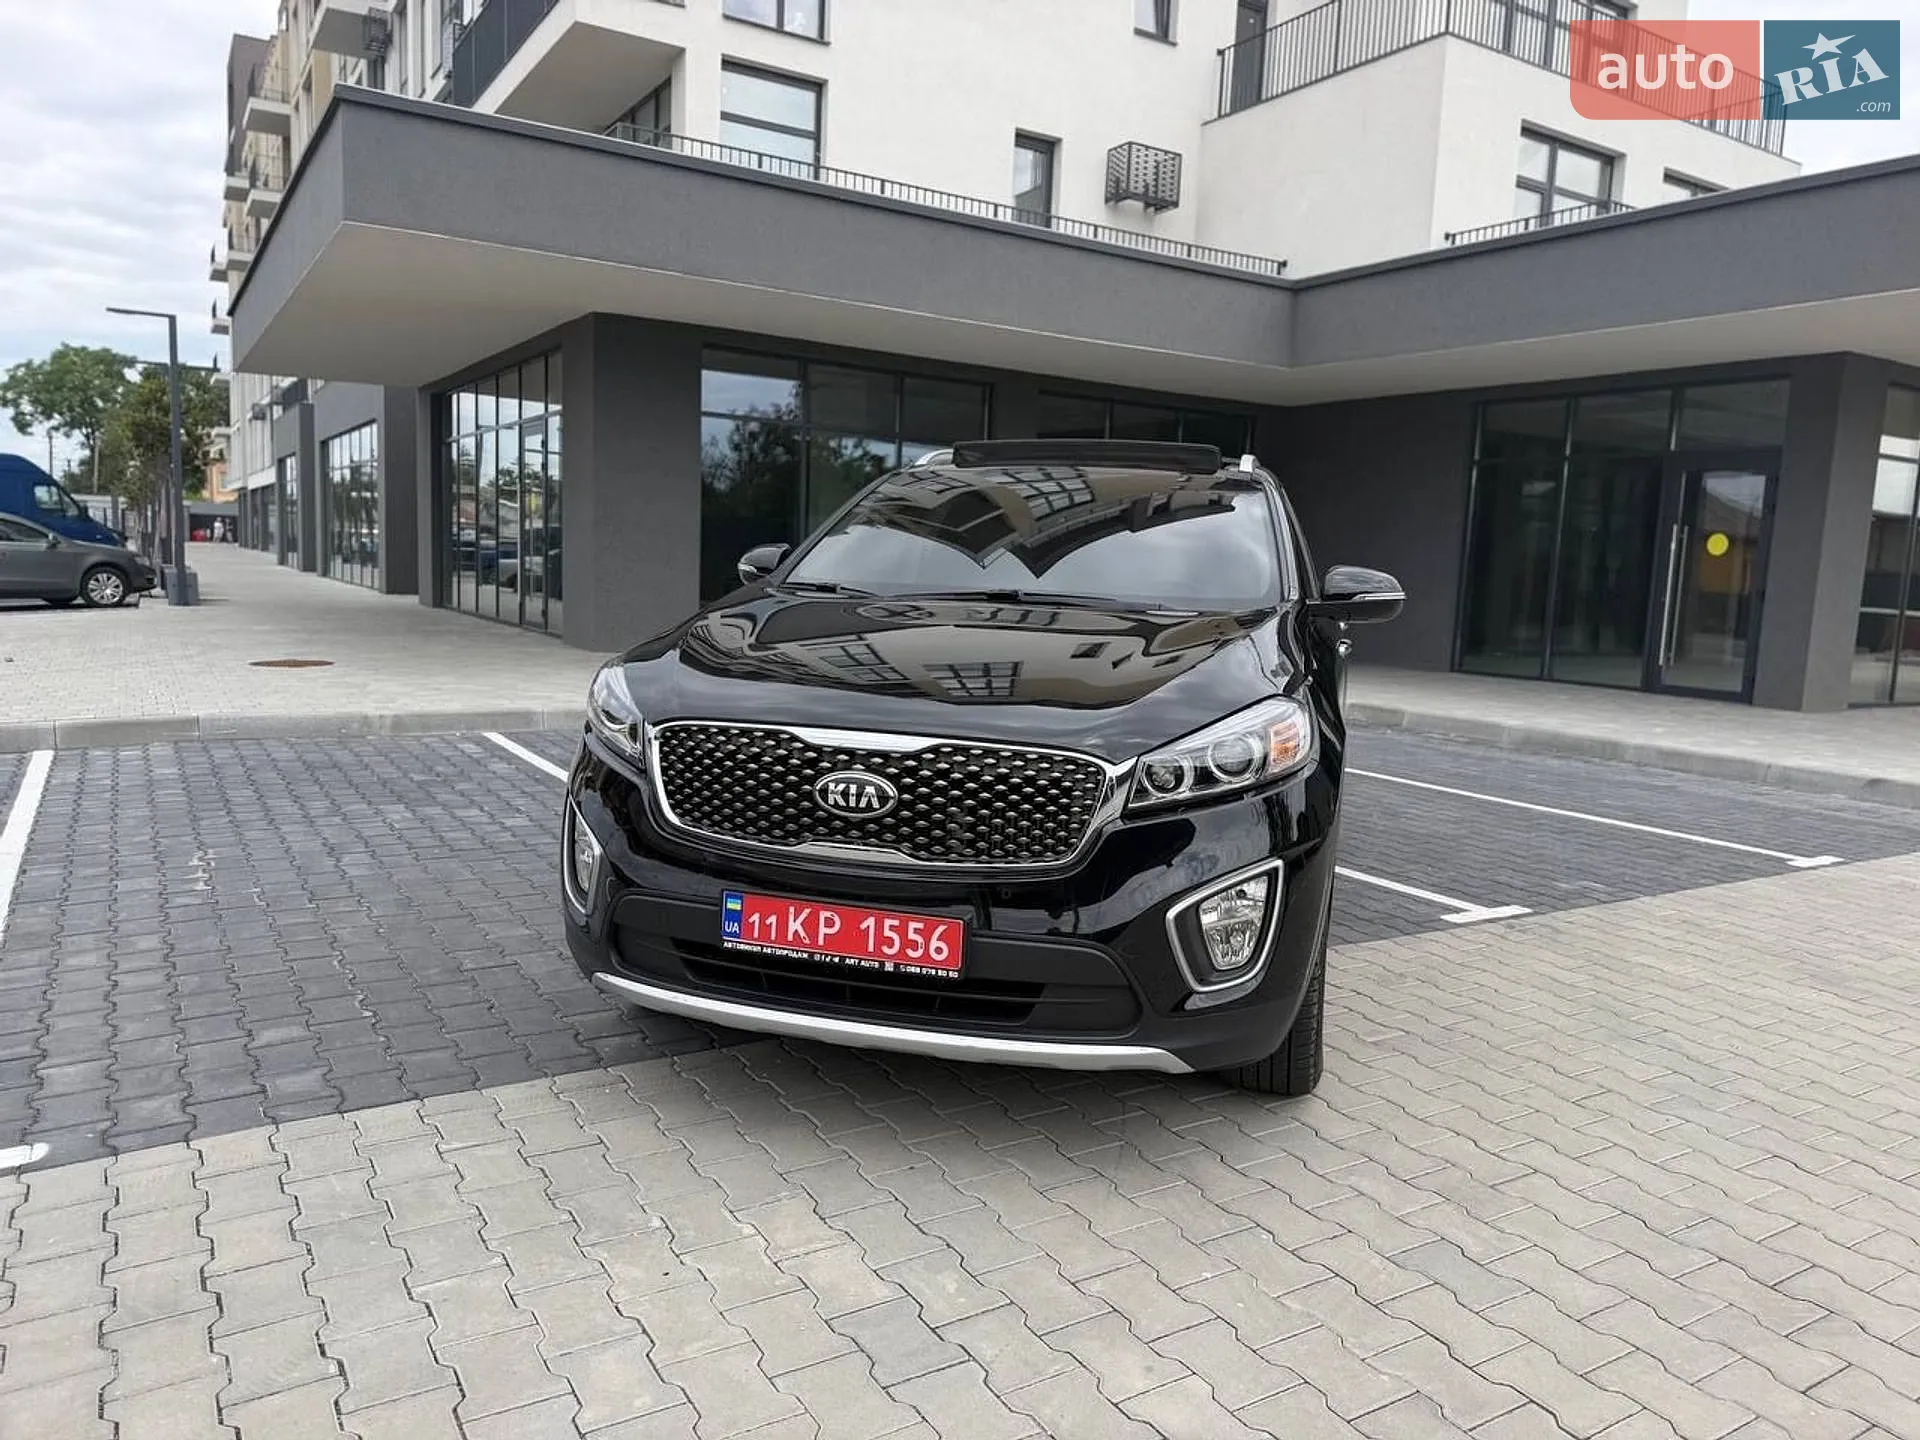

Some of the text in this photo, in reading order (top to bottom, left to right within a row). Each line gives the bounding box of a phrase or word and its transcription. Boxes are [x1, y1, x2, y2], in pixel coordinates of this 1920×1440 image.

[827, 781, 881, 809] KIA
[724, 920, 741, 934] UA
[859, 915, 950, 961] 1556
